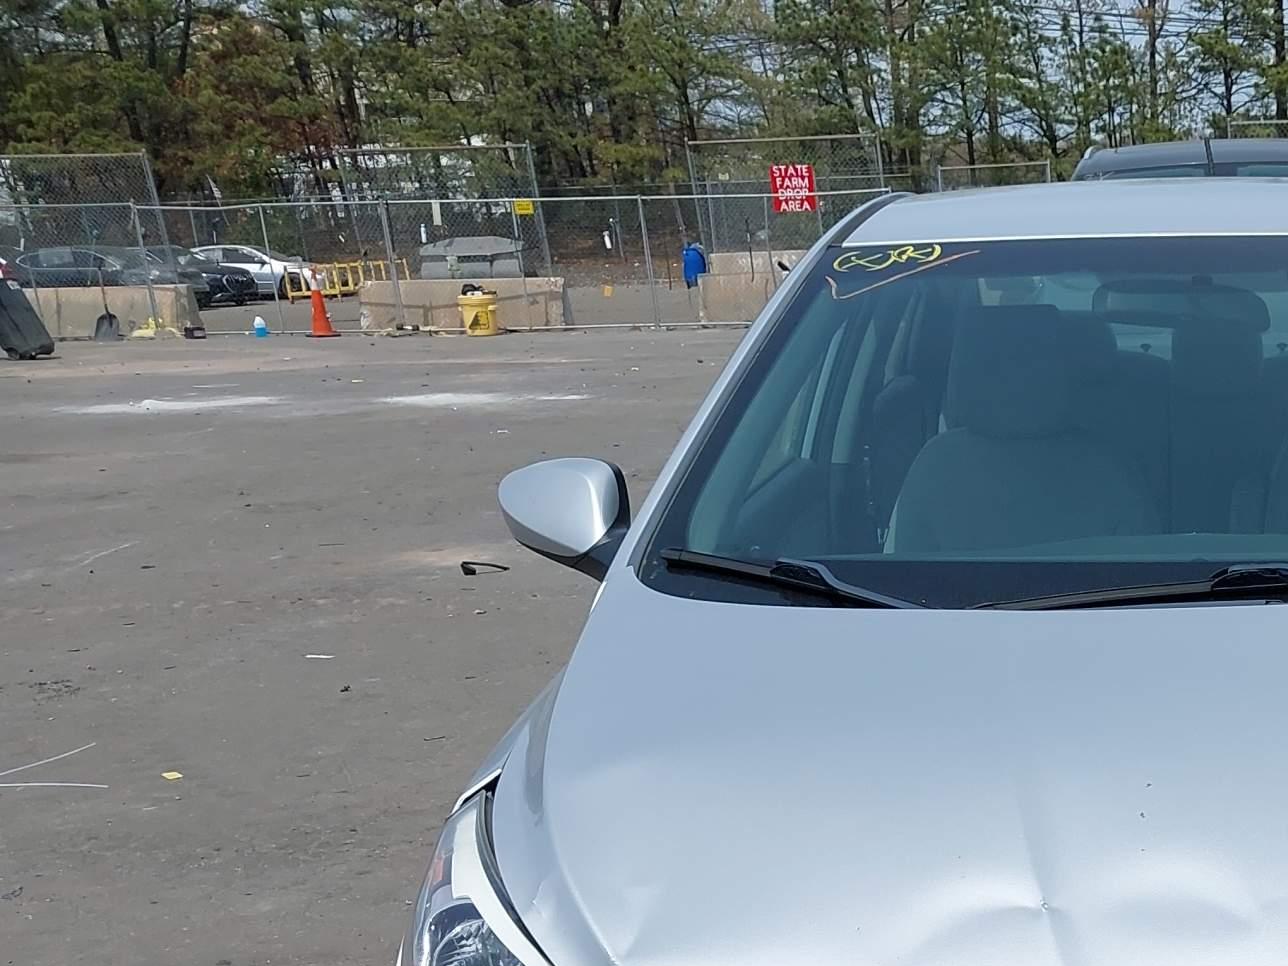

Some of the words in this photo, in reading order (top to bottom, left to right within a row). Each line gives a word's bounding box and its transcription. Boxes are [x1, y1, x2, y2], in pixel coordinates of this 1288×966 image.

[772, 165, 810, 177] STATE
[775, 177, 810, 189] FARM
[778, 189, 809, 200] DROP
[780, 201, 812, 212] AREA
